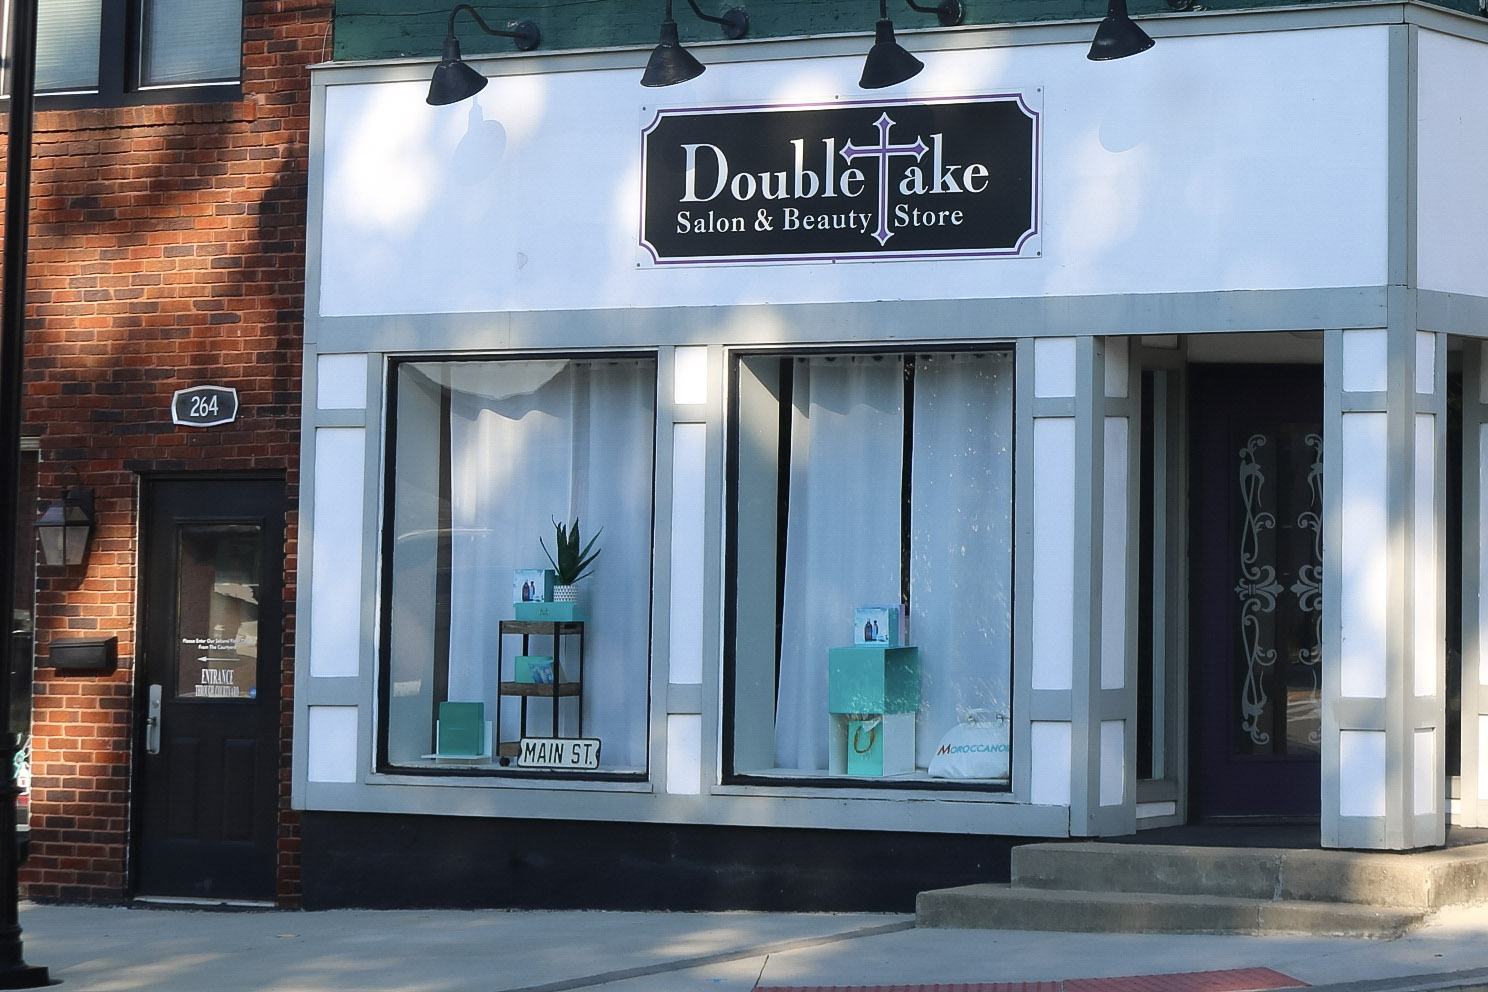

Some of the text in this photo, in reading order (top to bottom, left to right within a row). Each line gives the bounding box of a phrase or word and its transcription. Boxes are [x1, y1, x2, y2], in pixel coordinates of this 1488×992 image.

[679, 137, 866, 203] Double
[676, 204, 964, 234] Salon & Beauty Store
[189, 394, 219, 417] 264
[201, 668, 235, 685] ENTRANCE
[523, 742, 593, 765] MAIN ST.
